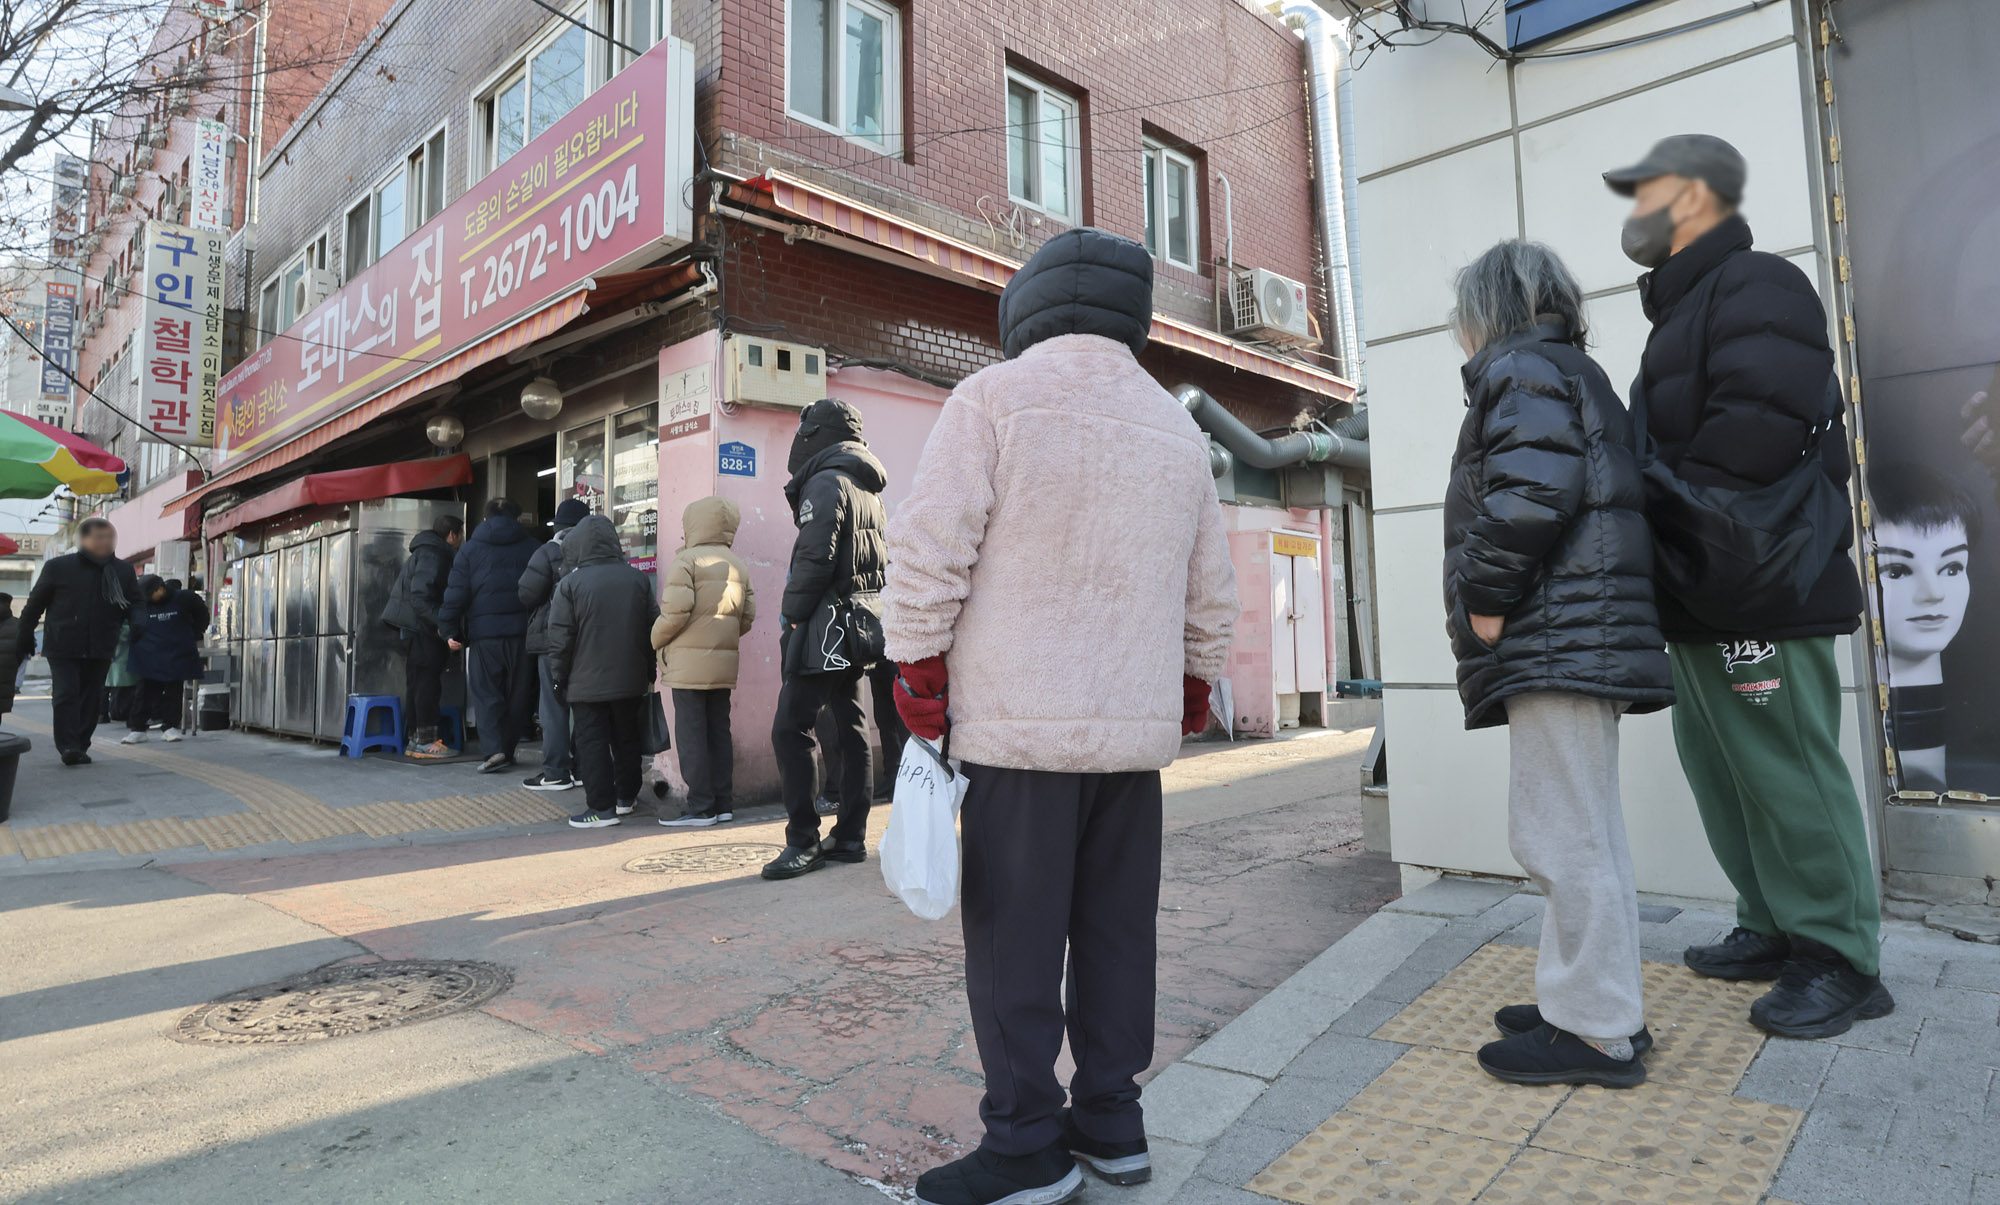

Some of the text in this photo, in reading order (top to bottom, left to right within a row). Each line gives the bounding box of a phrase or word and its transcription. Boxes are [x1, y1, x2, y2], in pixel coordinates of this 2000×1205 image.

[464, 90, 639, 242] 도움의 손길이 필요합니다
[199, 189, 219, 225] 사우나
[297, 224, 444, 393] 토마스의 집
[231, 377, 288, 440] 사랑의 급식소
[670, 400, 700, 421] 토마스의 집
[721, 457, 753, 472] 828-1
